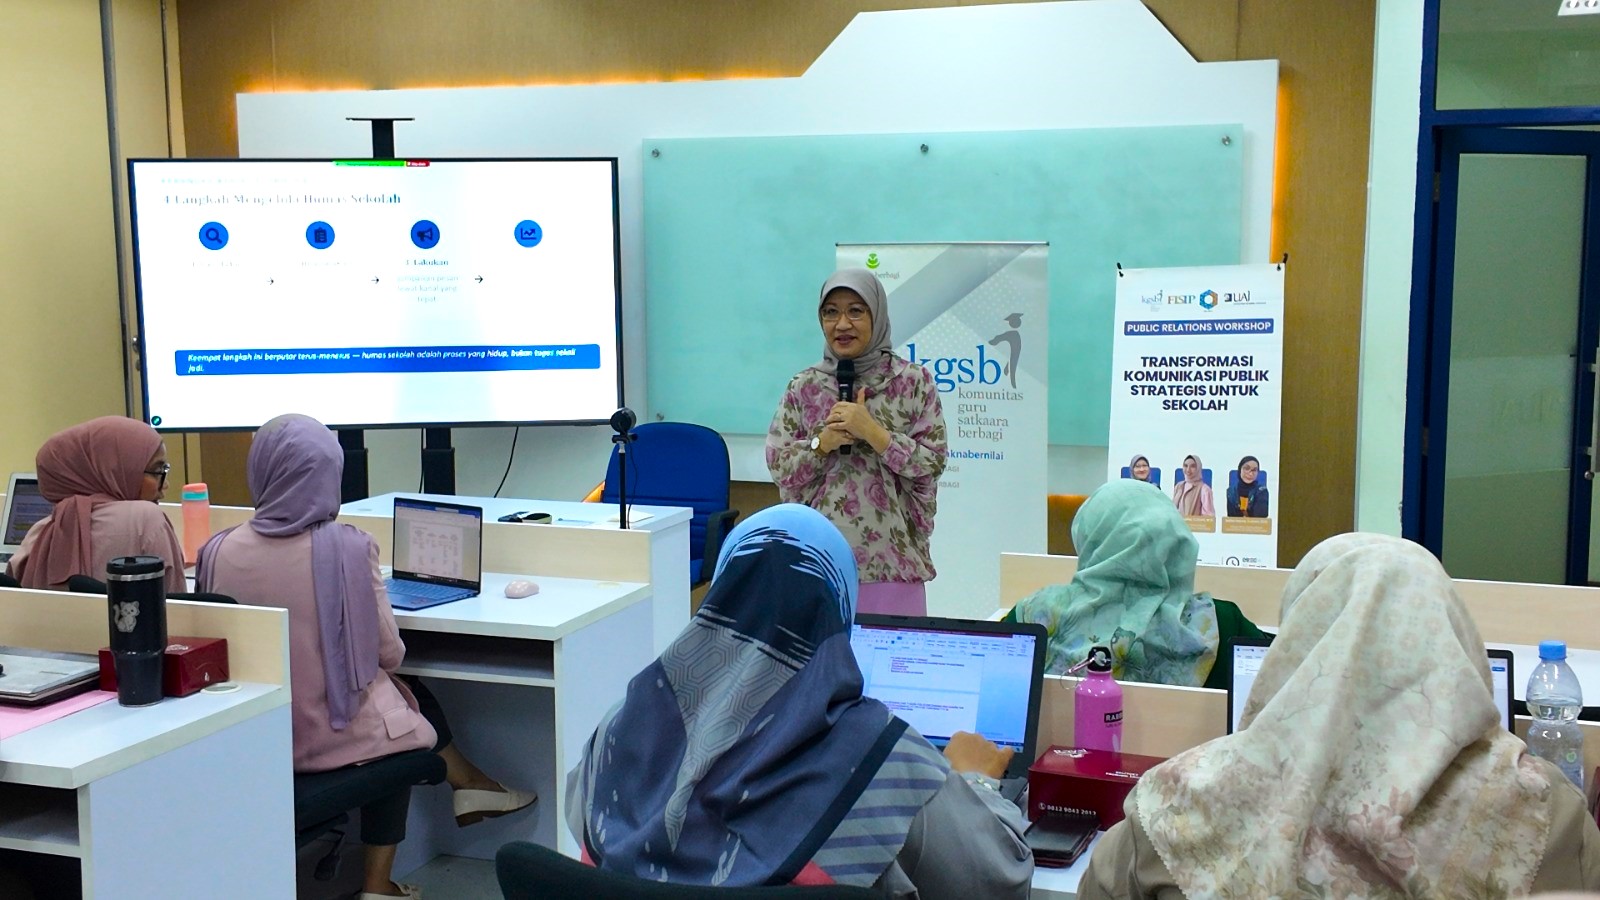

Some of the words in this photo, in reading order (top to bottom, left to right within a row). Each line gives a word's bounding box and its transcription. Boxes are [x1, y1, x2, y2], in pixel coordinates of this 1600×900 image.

[351, 193, 401, 204] Sekolah
[413, 258, 449, 266] Lakukan
[1168, 295, 1196, 304] FISIP
[1127, 323, 1160, 333] PUBLIC
[1162, 322, 1212, 332] RELATIONS
[1215, 321, 1271, 331] WORKSHOP
[362, 351, 386, 359] humas
[388, 350, 415, 359] sekolah
[417, 350, 442, 359] adalah
[468, 350, 485, 360] yang
[1141, 356, 1254, 367] TRANSFORMASI
[906, 343, 1002, 392] kgsb
[1124, 370, 1217, 382] KOMUNIKASI
[1219, 370, 1269, 381] PUBLIK
[958, 387, 1024, 400] komunitas
[1130, 385, 1206, 396] STRATEGIS
[1209, 385, 1259, 396] UNTUK
[957, 403, 987, 414] guru
[1162, 399, 1228, 411] SEKOLAH
[957, 415, 1009, 427] satkaara
[958, 426, 1003, 442] berbagi
[946, 449, 1004, 460] aknabernilai
